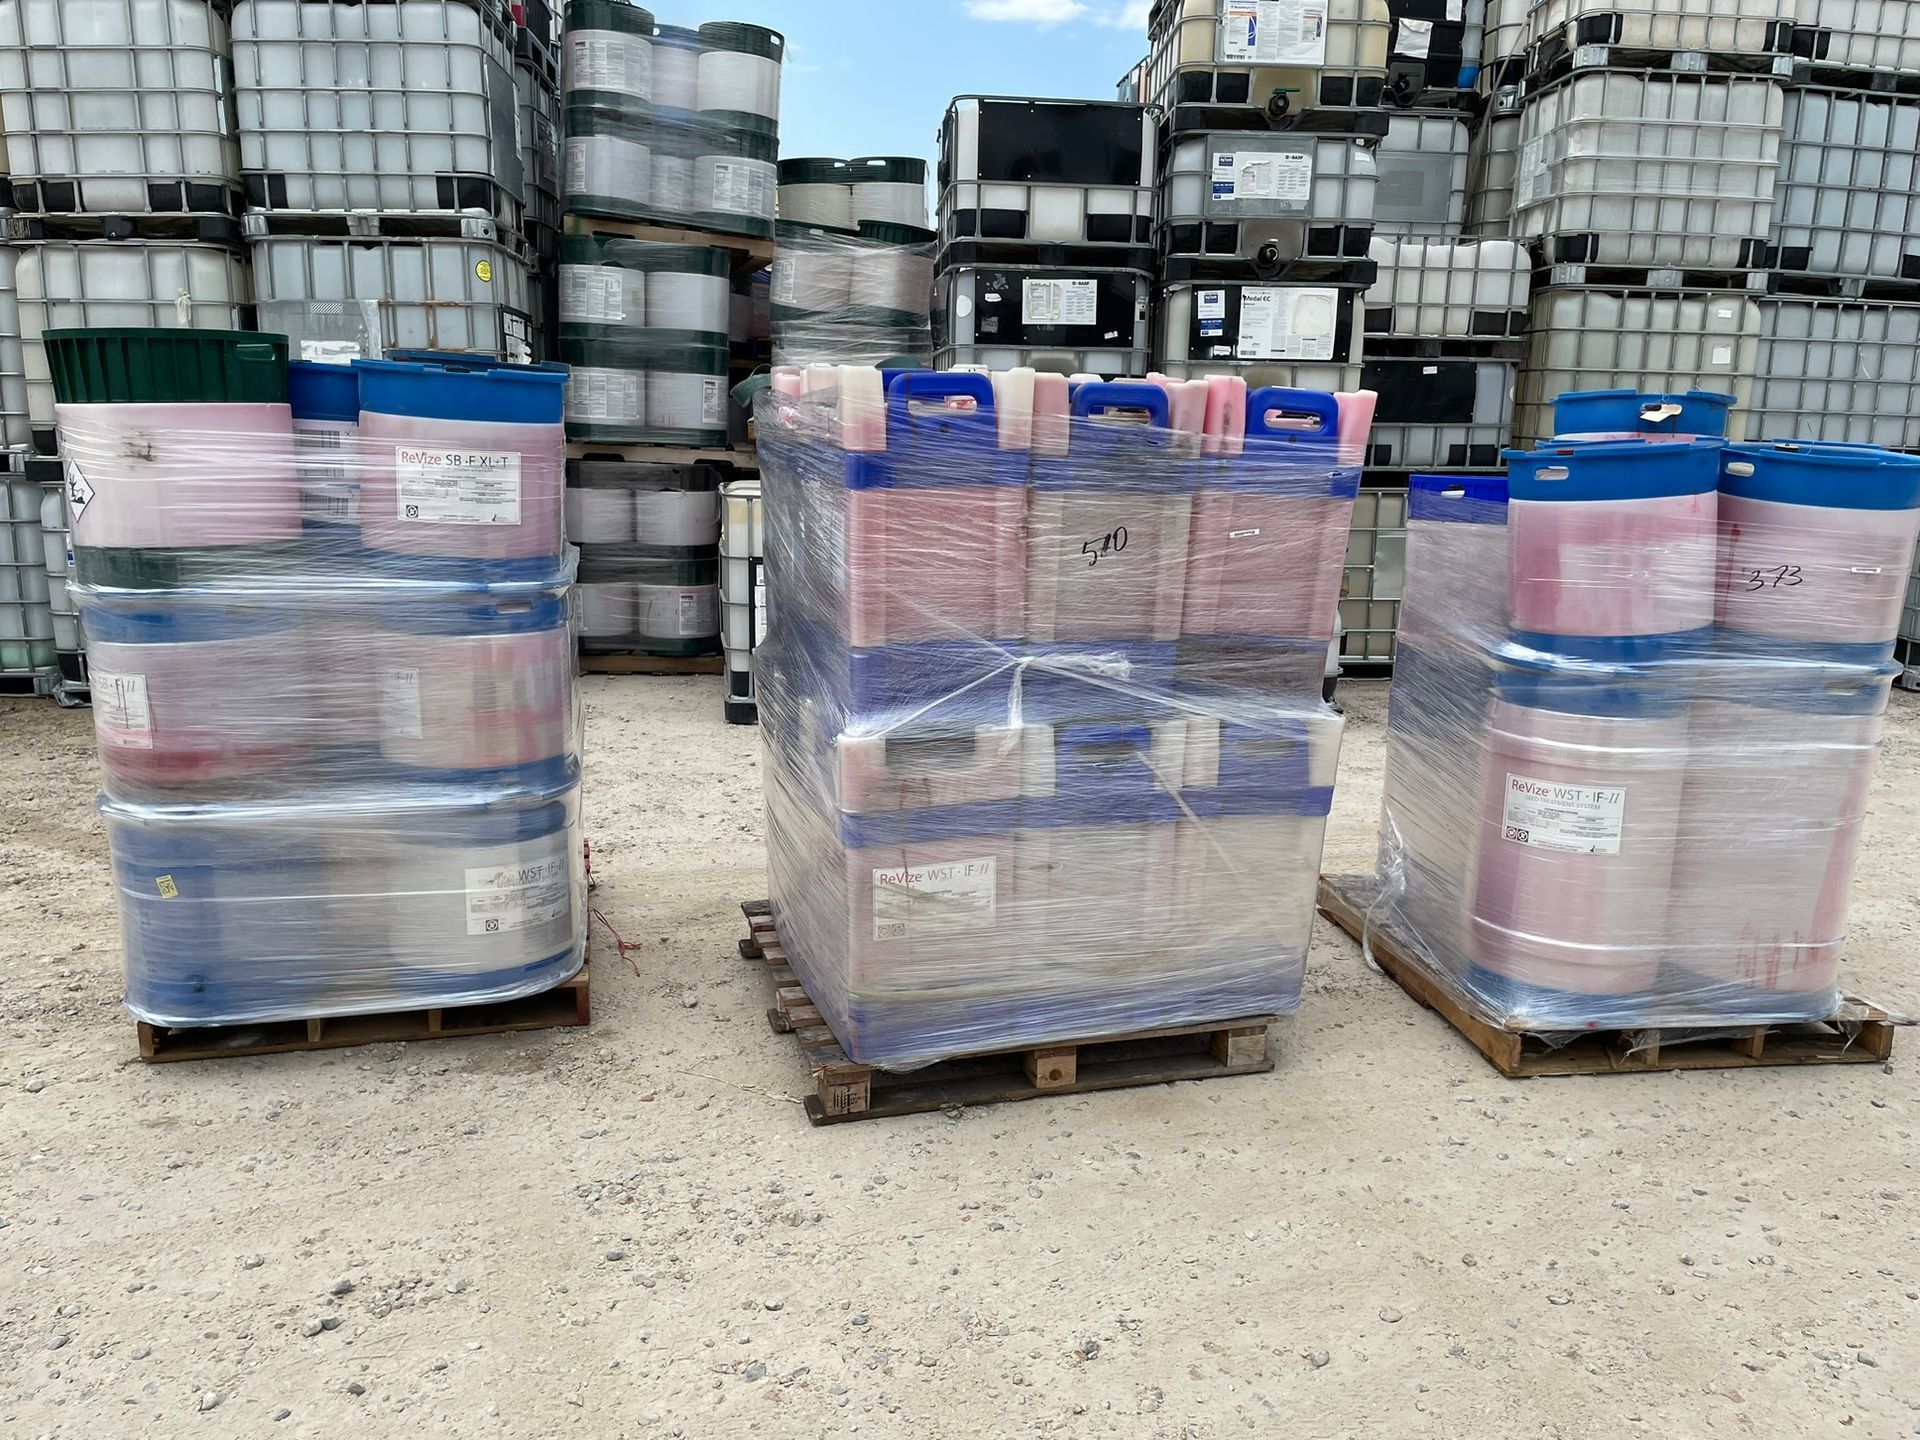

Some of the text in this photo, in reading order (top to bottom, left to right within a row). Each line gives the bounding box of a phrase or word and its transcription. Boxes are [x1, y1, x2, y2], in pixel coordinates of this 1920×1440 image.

[401, 451, 442, 466] ReVize
[445, 454, 462, 467] SB
[1746, 565, 1803, 592] 373
[1512, 779, 1549, 796] ReVize
[1553, 787, 1583, 801] WST
[1540, 797, 1575, 808] TREATMENT
[518, 865, 544, 881] WST
[880, 873, 923, 885] ReVize
[927, 868, 955, 880] WST
